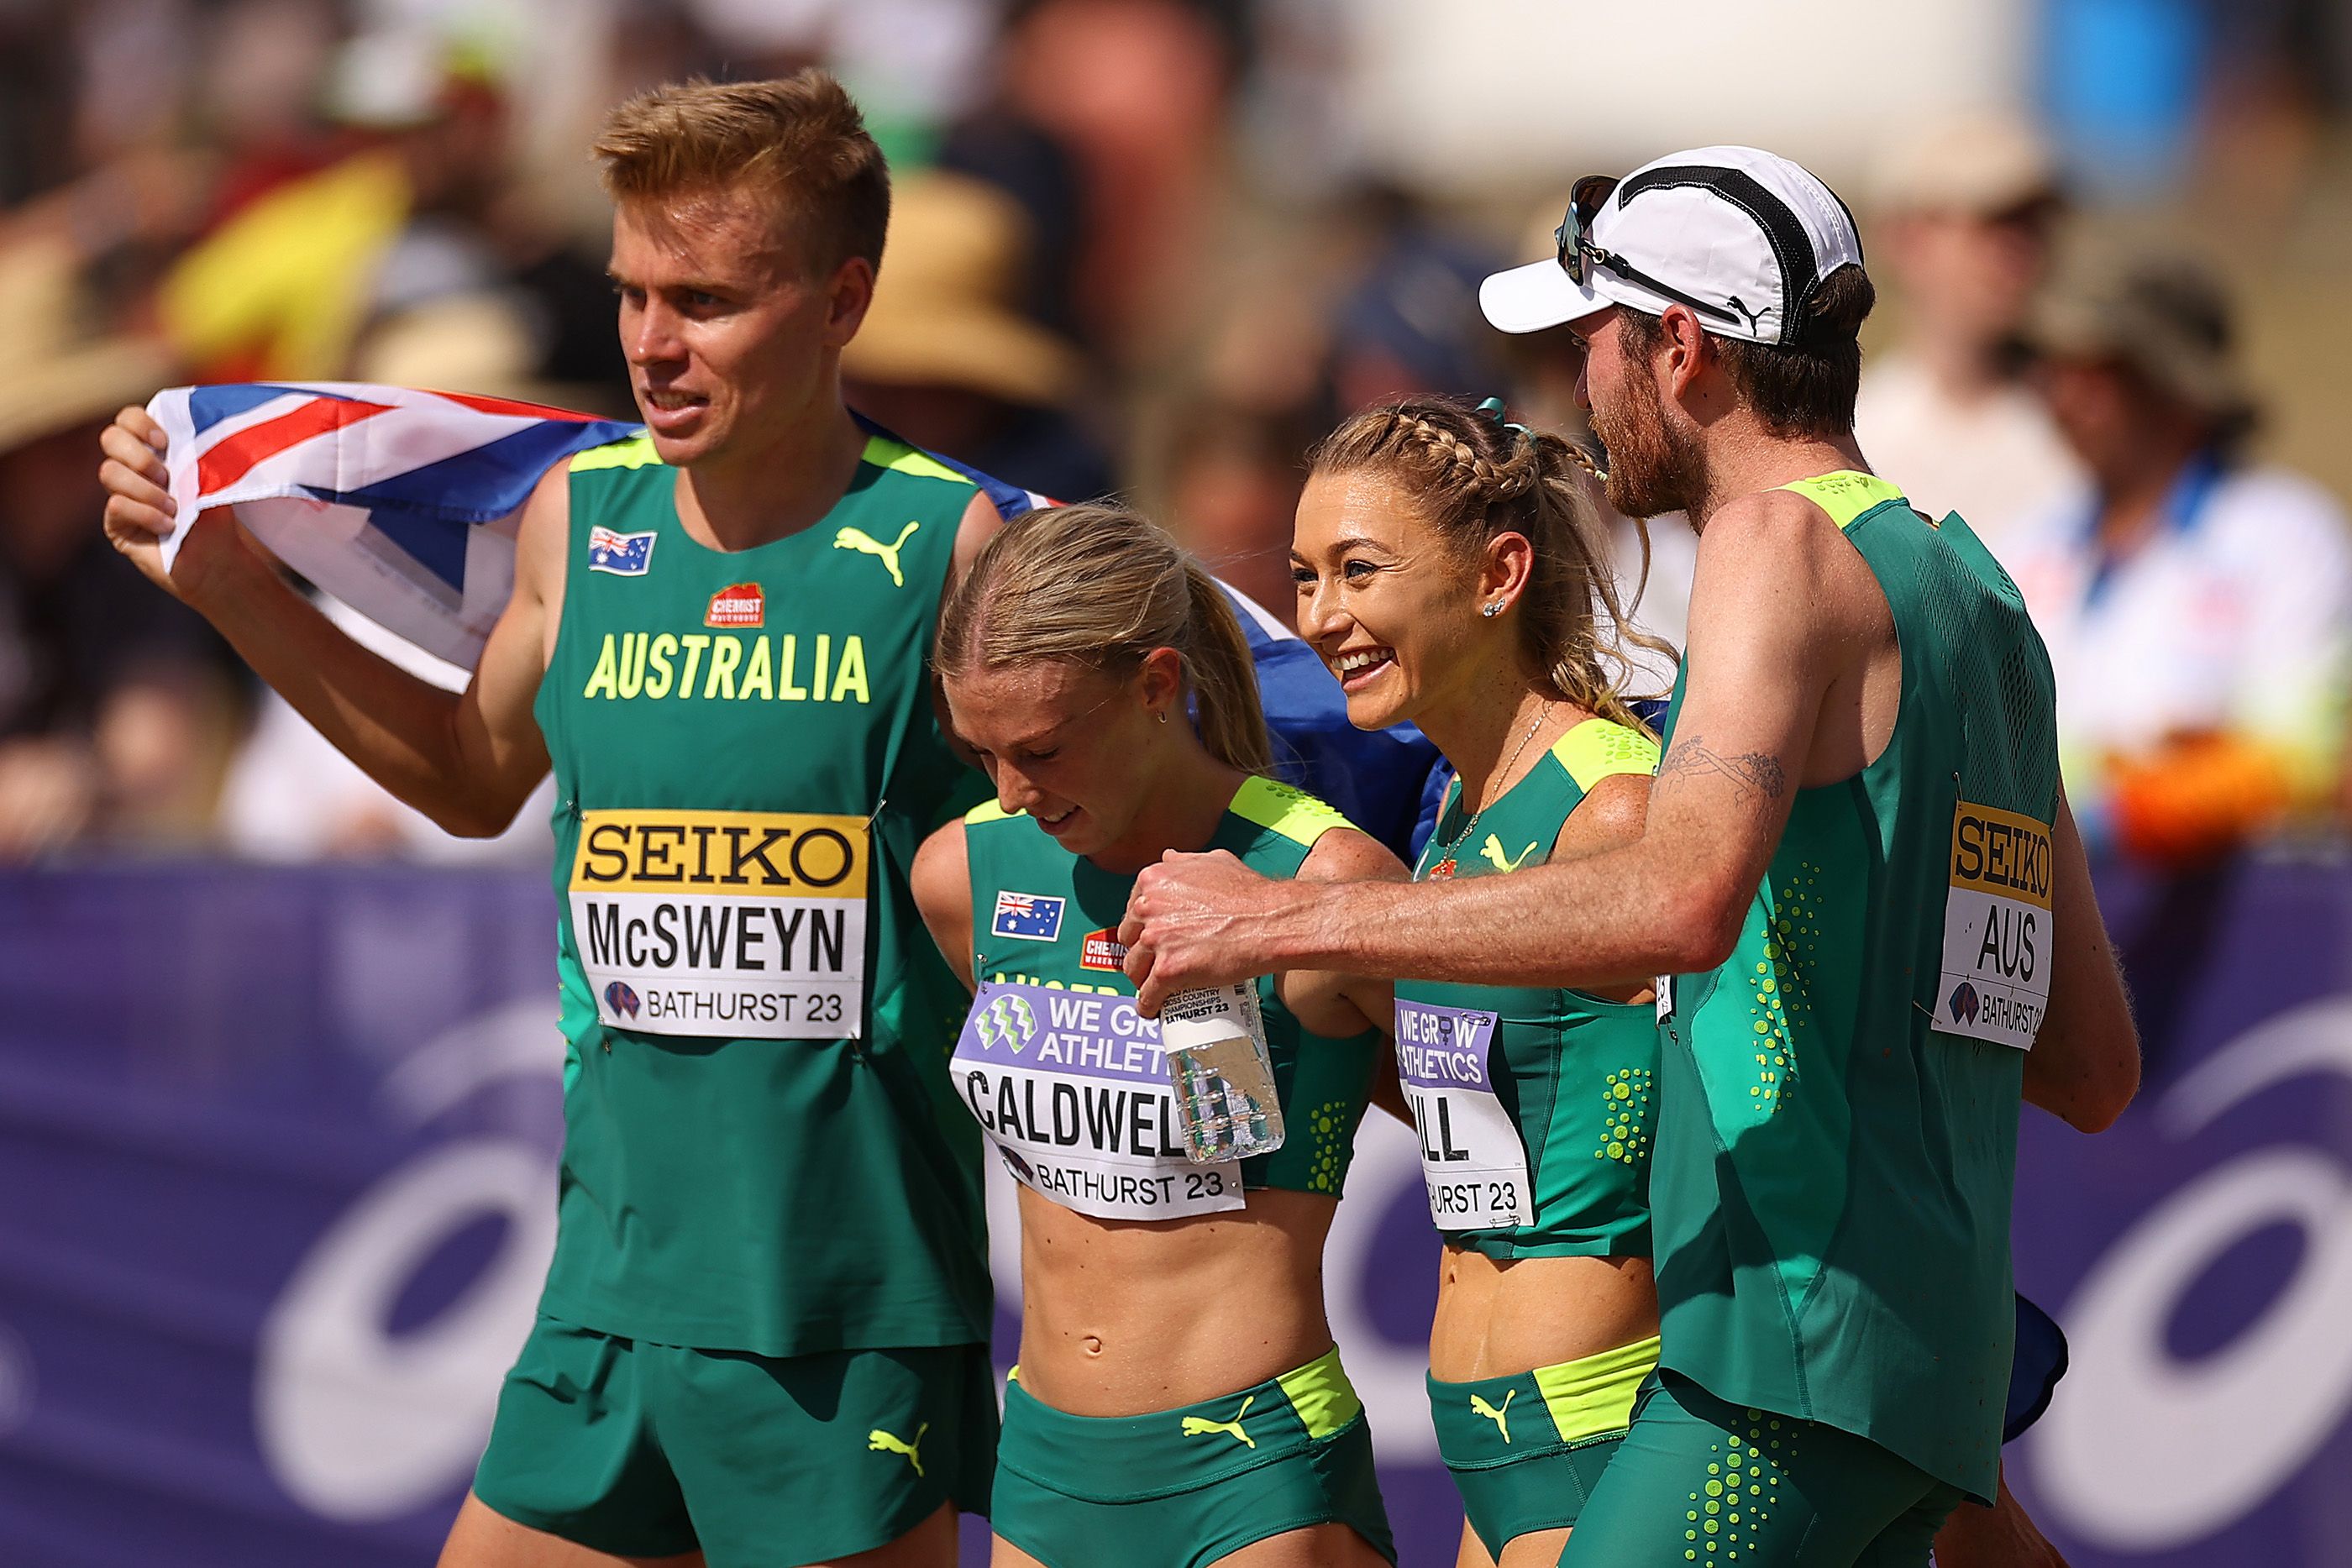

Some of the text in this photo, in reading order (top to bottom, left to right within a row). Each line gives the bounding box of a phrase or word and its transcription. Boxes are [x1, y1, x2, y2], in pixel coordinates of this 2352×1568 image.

[711, 599, 761, 613] CHEMIST
[583, 632, 870, 703] AUSTRALIA
[583, 824, 853, 888] SEIKO
[1956, 815, 2050, 898] SEIKO
[586, 903, 845, 972] McSWEYN
[1977, 905, 2036, 983] AUS
[648, 991, 842, 1021] BATHURST 23
[1183, 989, 1220, 1002] COUNTRY
[1215, 1003, 1230, 1013] 23
[1982, 994, 2034, 1034] BATHURST
[1049, 997, 1160, 1039] WE GR
[1400, 1009, 1419, 1041] WE
[1037, 1032, 1171, 1076] ATHLET
[1401, 1045, 1483, 1083] ATHLETICS
[967, 1070, 1187, 1157] CALDWEL
[1037, 1164, 1224, 1205] BATHURST 23
[1489, 1182, 1517, 1211] 23
